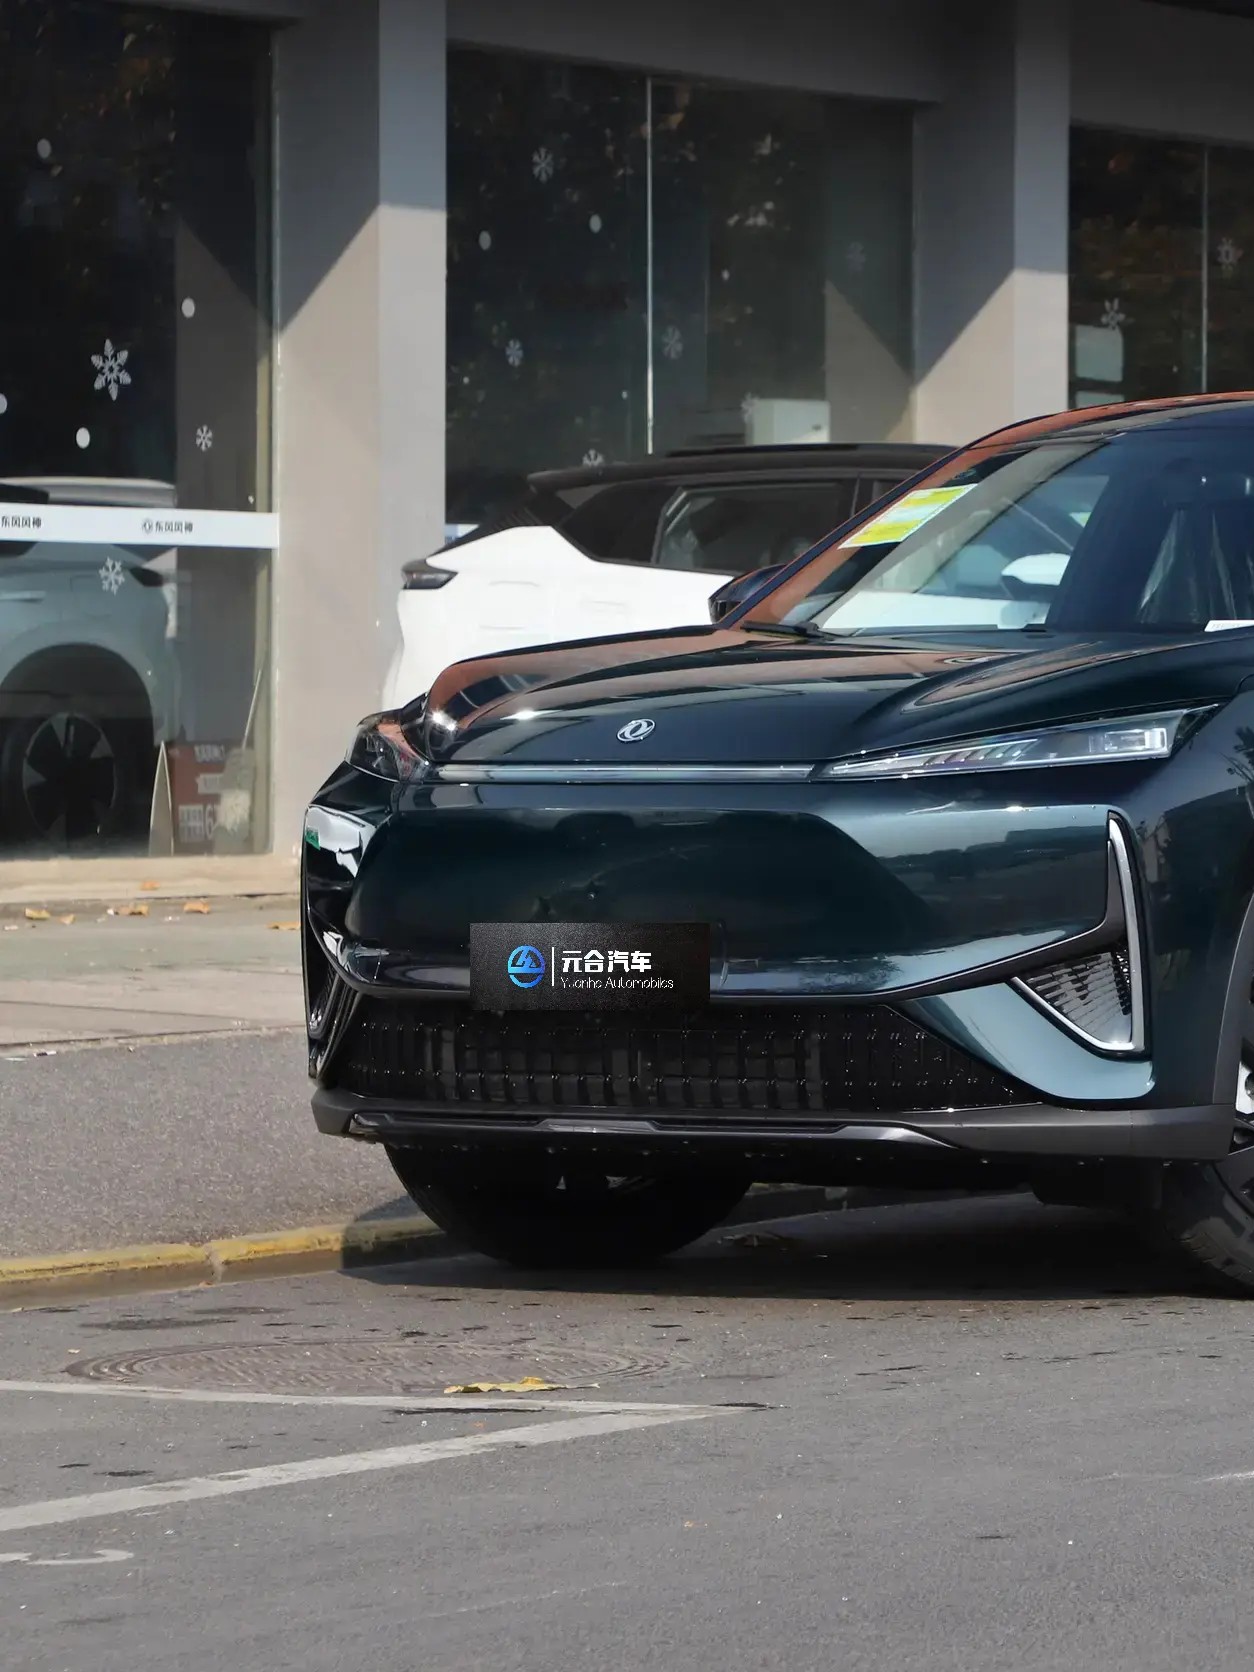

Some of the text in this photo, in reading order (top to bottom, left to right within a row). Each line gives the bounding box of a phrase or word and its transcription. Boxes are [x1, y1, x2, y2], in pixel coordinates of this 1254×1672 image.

[1, 515, 42, 529] 东风风神
[155, 520, 194, 533] 东风风神
